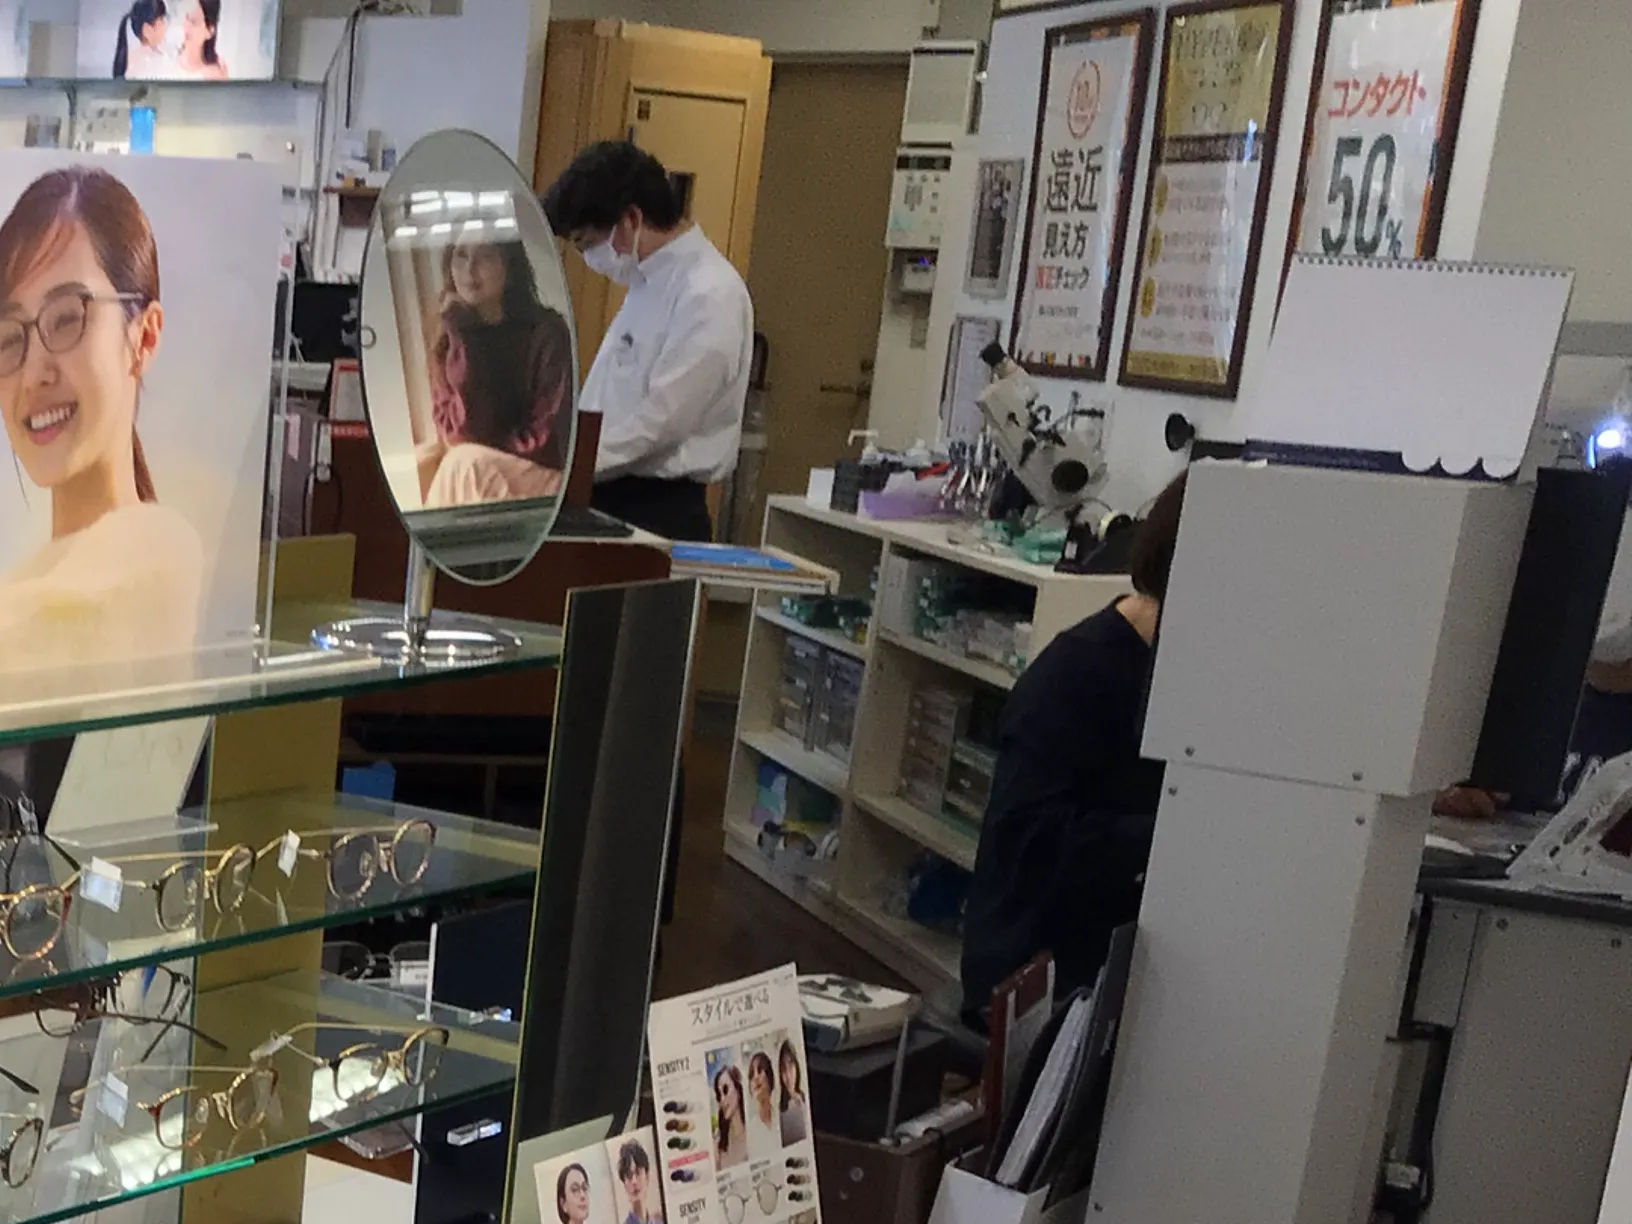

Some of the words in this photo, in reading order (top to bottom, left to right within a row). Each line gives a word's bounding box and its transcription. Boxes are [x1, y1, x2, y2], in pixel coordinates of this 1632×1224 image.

[1328, 69, 1426, 117] コンタクト
[1043, 146, 1103, 213] 遠近
[1321, 133, 1403, 259] 50%
[1042, 222, 1089, 259] 見え方
